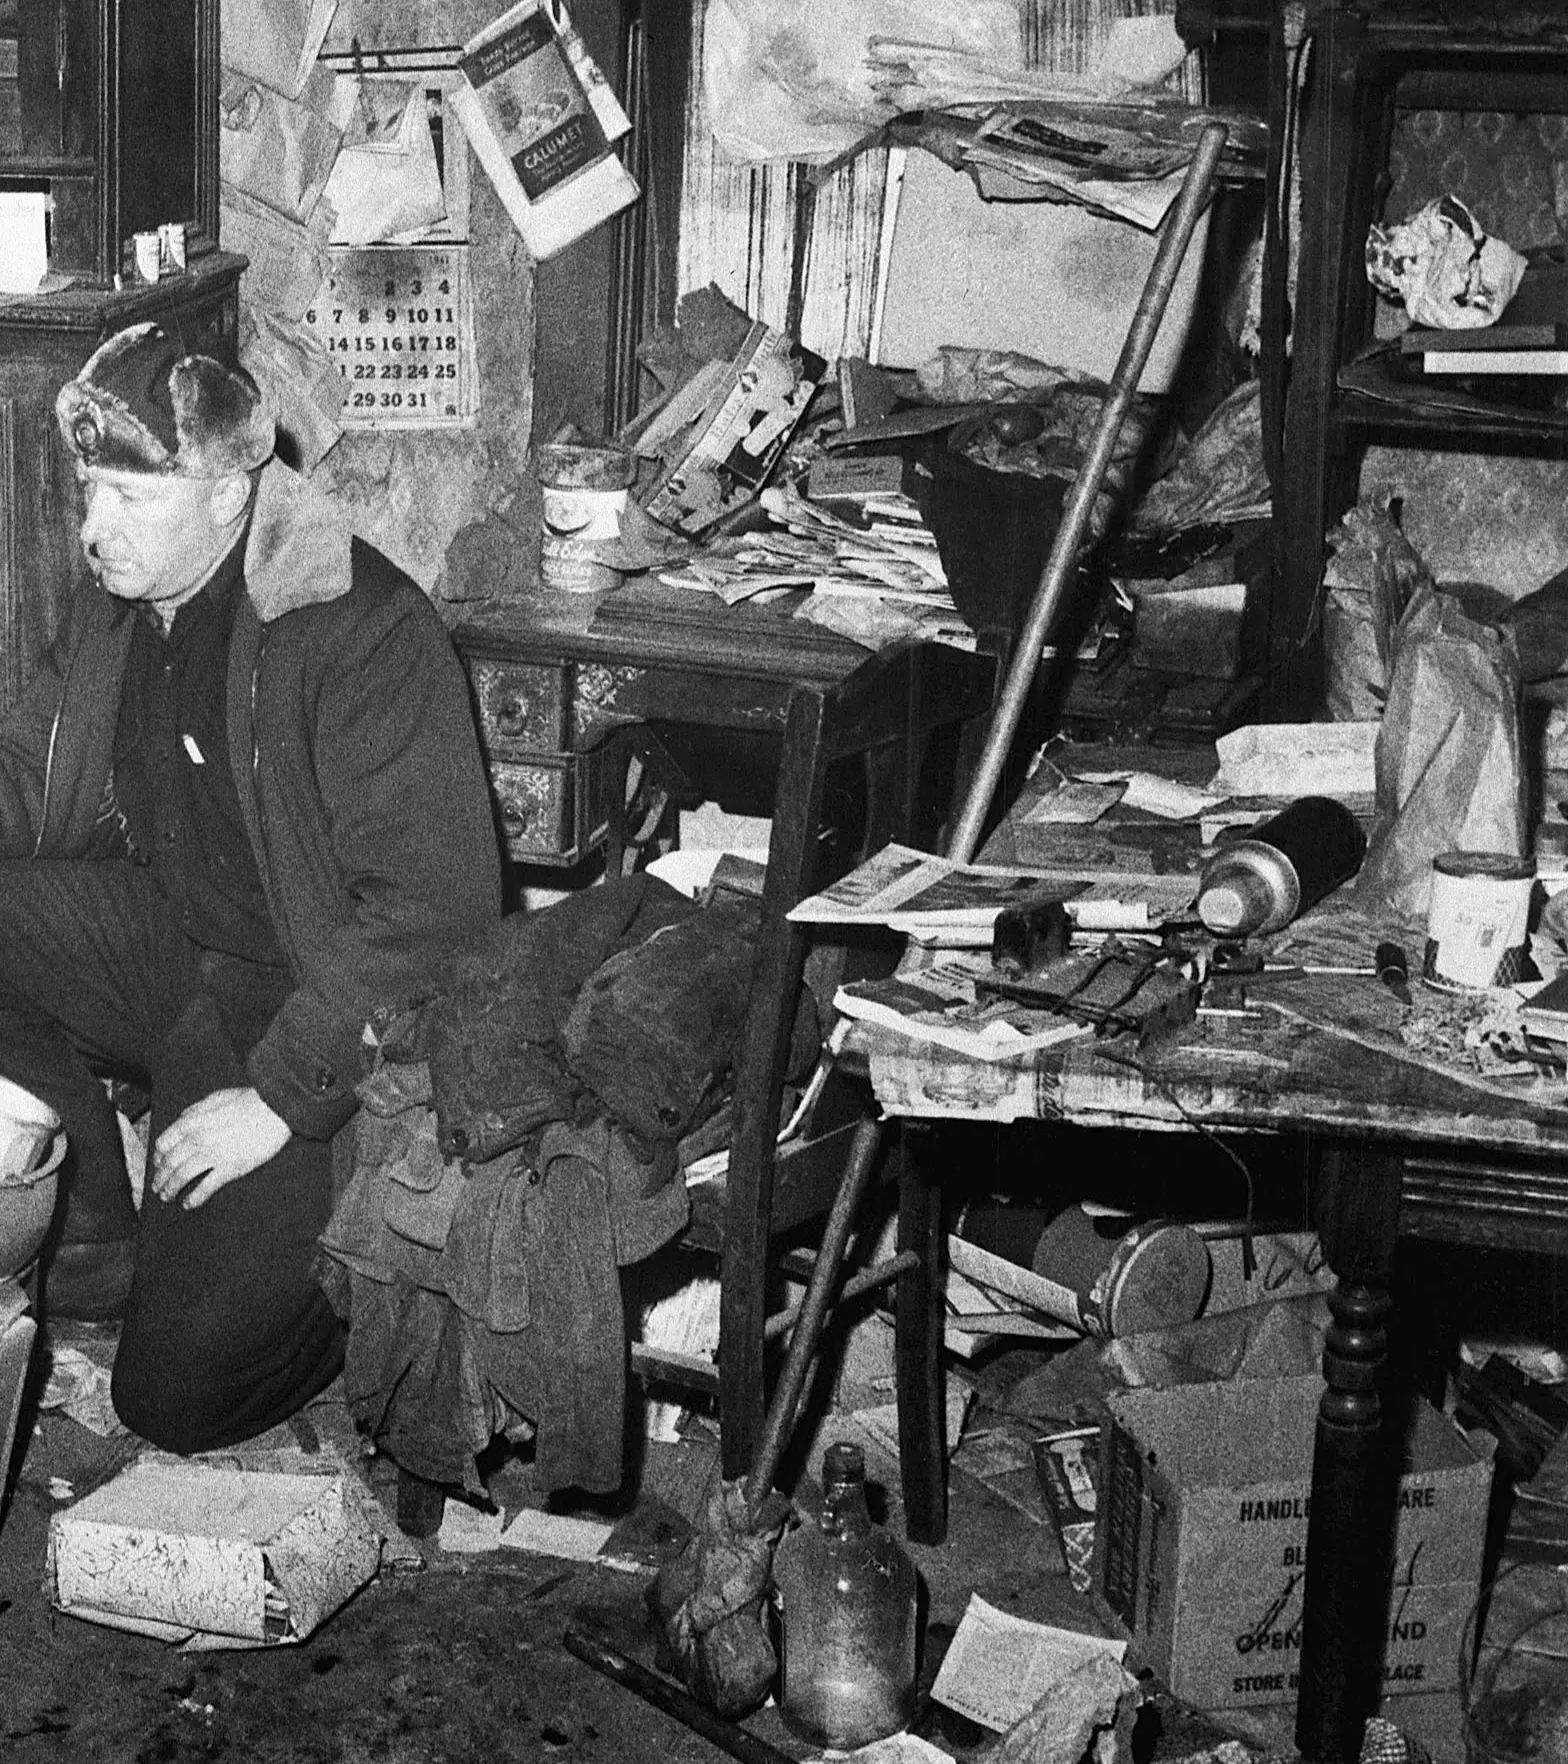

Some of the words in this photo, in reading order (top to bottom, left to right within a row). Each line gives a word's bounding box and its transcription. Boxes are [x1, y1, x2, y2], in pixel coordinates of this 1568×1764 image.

[524, 124, 583, 169] CALUMET
[385, 280, 396, 297] 2
[411, 279, 423, 296] 3
[438, 278, 450, 295] 4
[305, 309, 317, 324] 6
[333, 309, 343, 324] 7
[358, 308, 370, 324] 8
[385, 308, 397, 324] 9
[408, 308, 429, 324] 10
[435, 307, 454, 323] 11
[329, 336, 349, 352] 14
[354, 336, 376, 352] 15
[382, 336, 403, 352] 16
[408, 335, 430, 352] 17
[435, 335, 457, 351] 18
[353, 364, 376, 380] 22
[380, 364, 403, 380] 23
[407, 364, 429, 380] 24
[435, 364, 457, 380] 25
[353, 392, 376, 408] 29
[380, 392, 403, 408] 30
[407, 392, 427, 408] 31
[1399, 1487, 1435, 1509] ARE
[1386, 1621, 1427, 1642] ND
[1383, 1664, 1425, 1681] LACE
[1233, 1674, 1285, 1693] STORE
